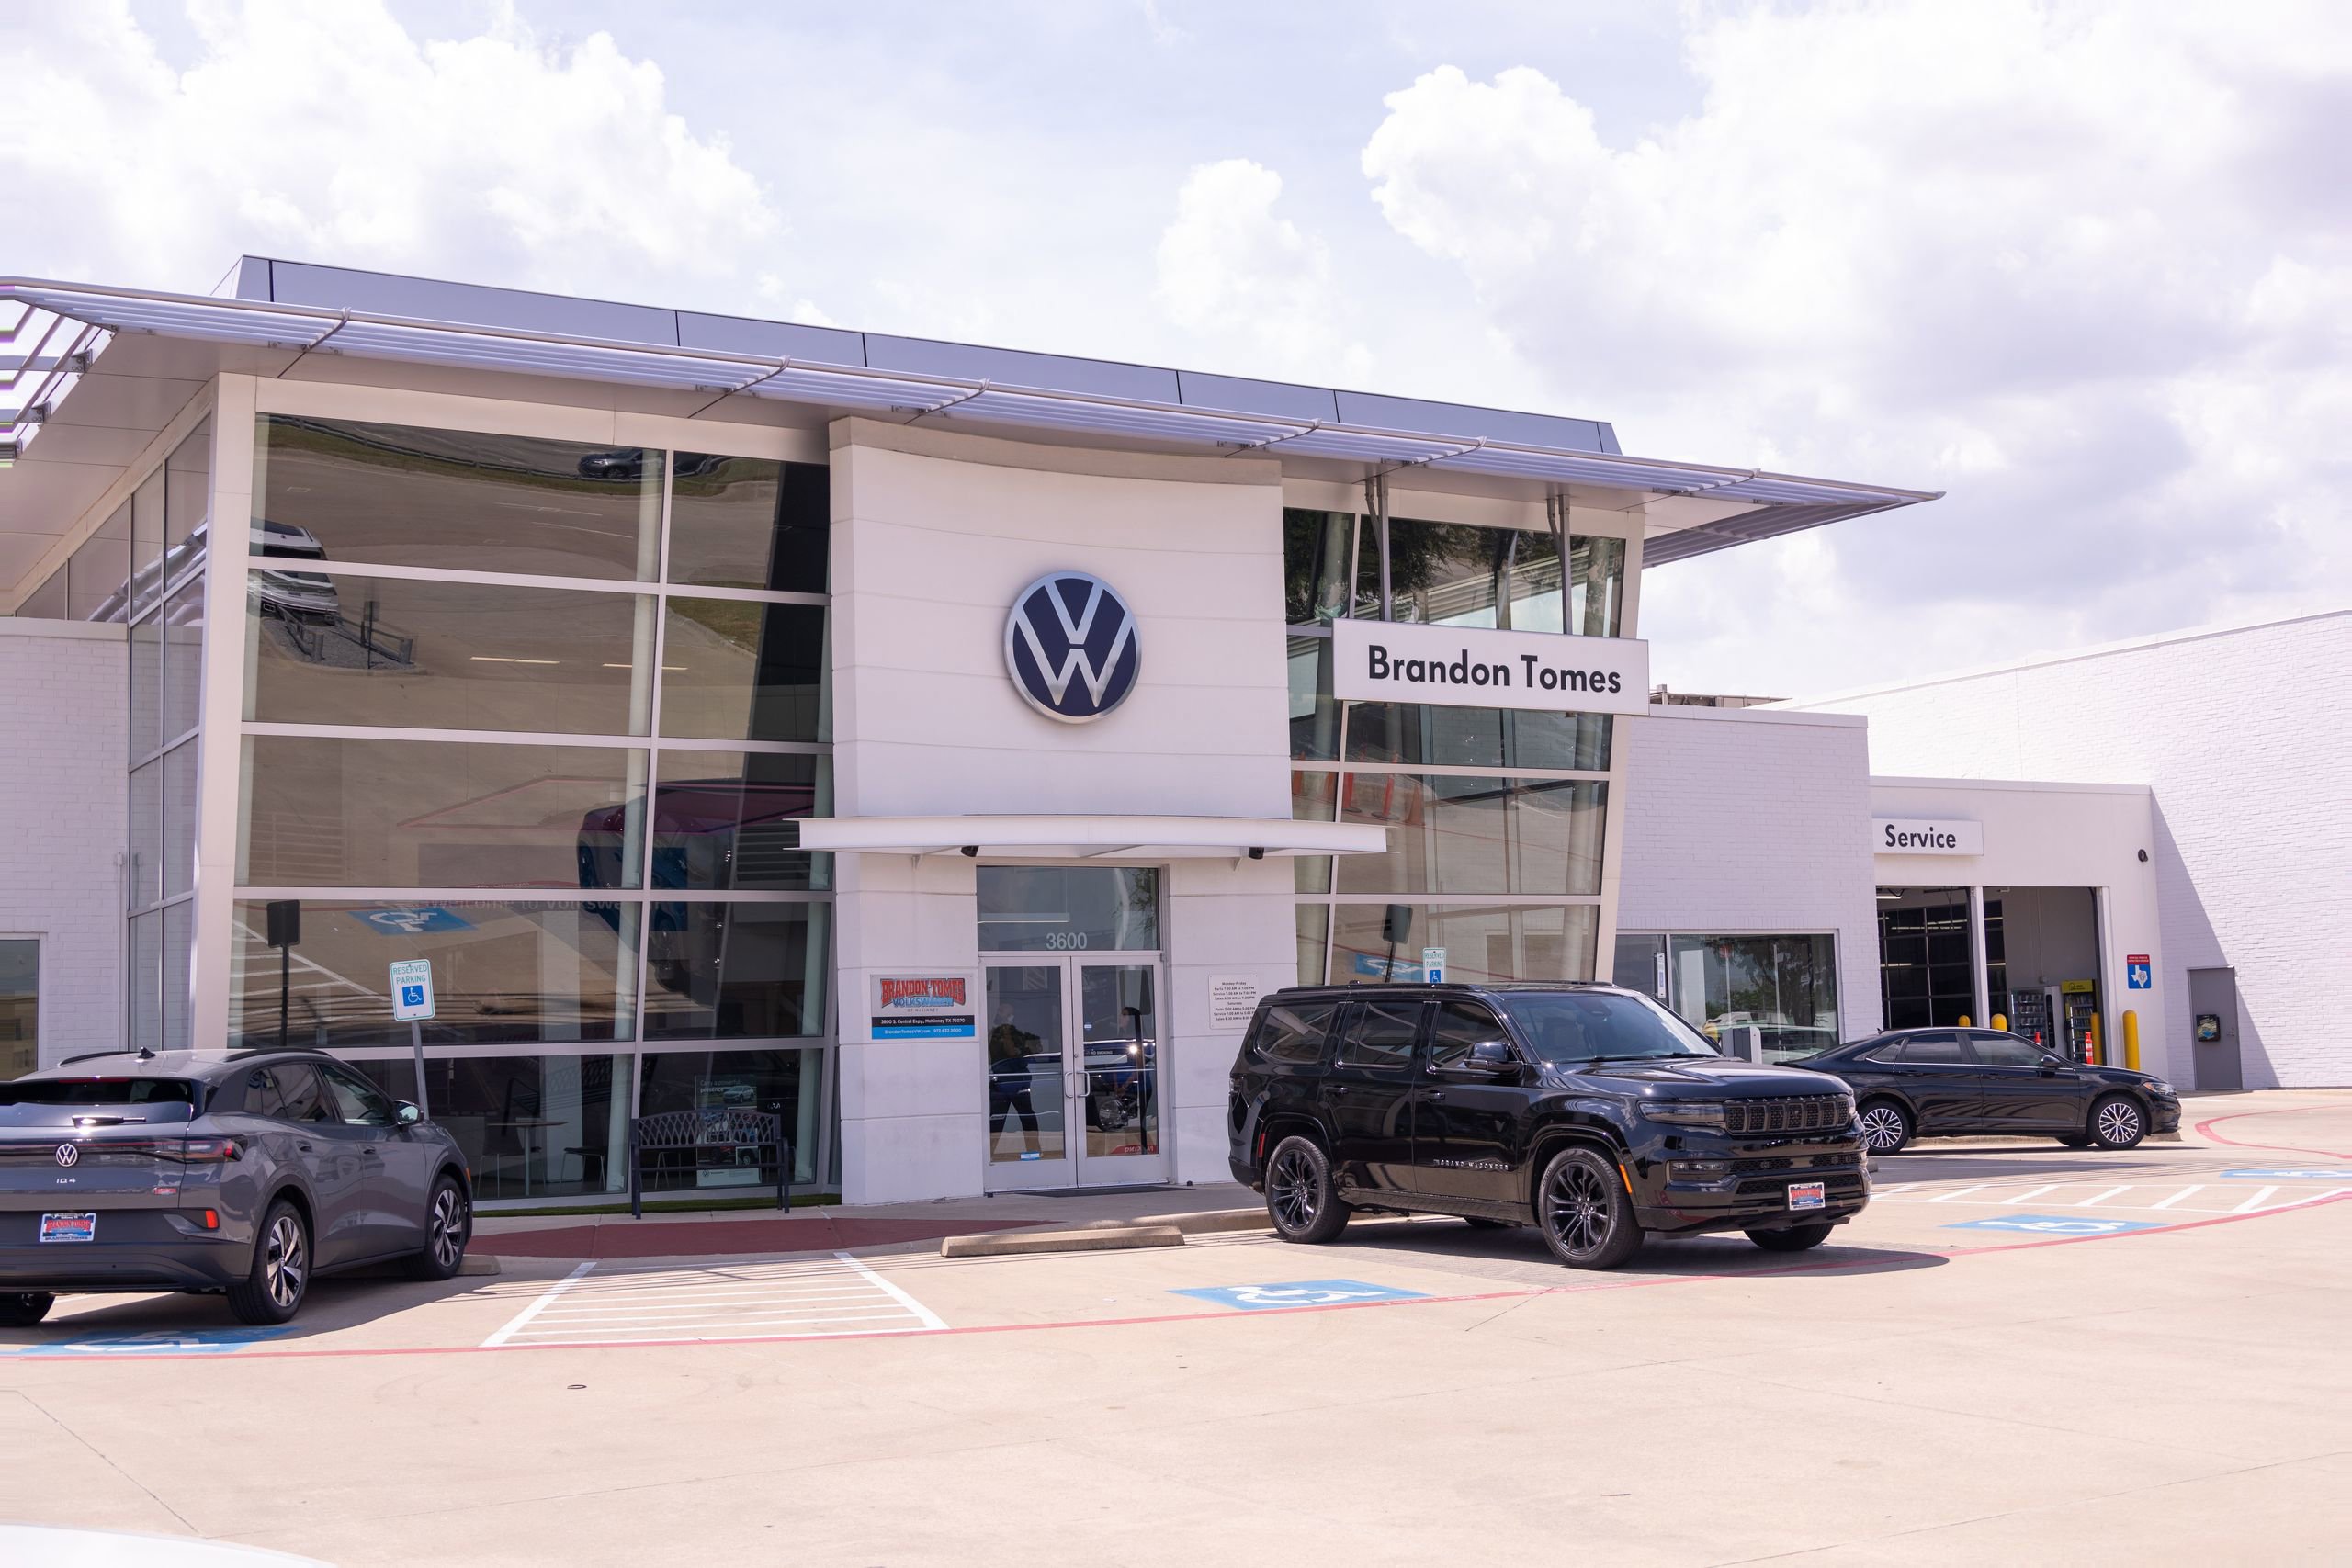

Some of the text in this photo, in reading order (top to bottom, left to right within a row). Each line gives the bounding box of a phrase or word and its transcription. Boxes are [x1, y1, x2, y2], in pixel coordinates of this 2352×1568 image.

[1008, 573, 1139, 715] VW
[1368, 644, 1622, 694] Brandon Tomes
[1884, 824, 1957, 849] Service
[543, 900, 661, 910] Volkswan
[1046, 932, 1088, 950] 3600
[393, 964, 428, 974] RESERVED
[396, 975, 426, 984] PARKING
[881, 978, 965, 1007] BRANDON TOMES
[893, 997, 954, 1007] VOLKSW
